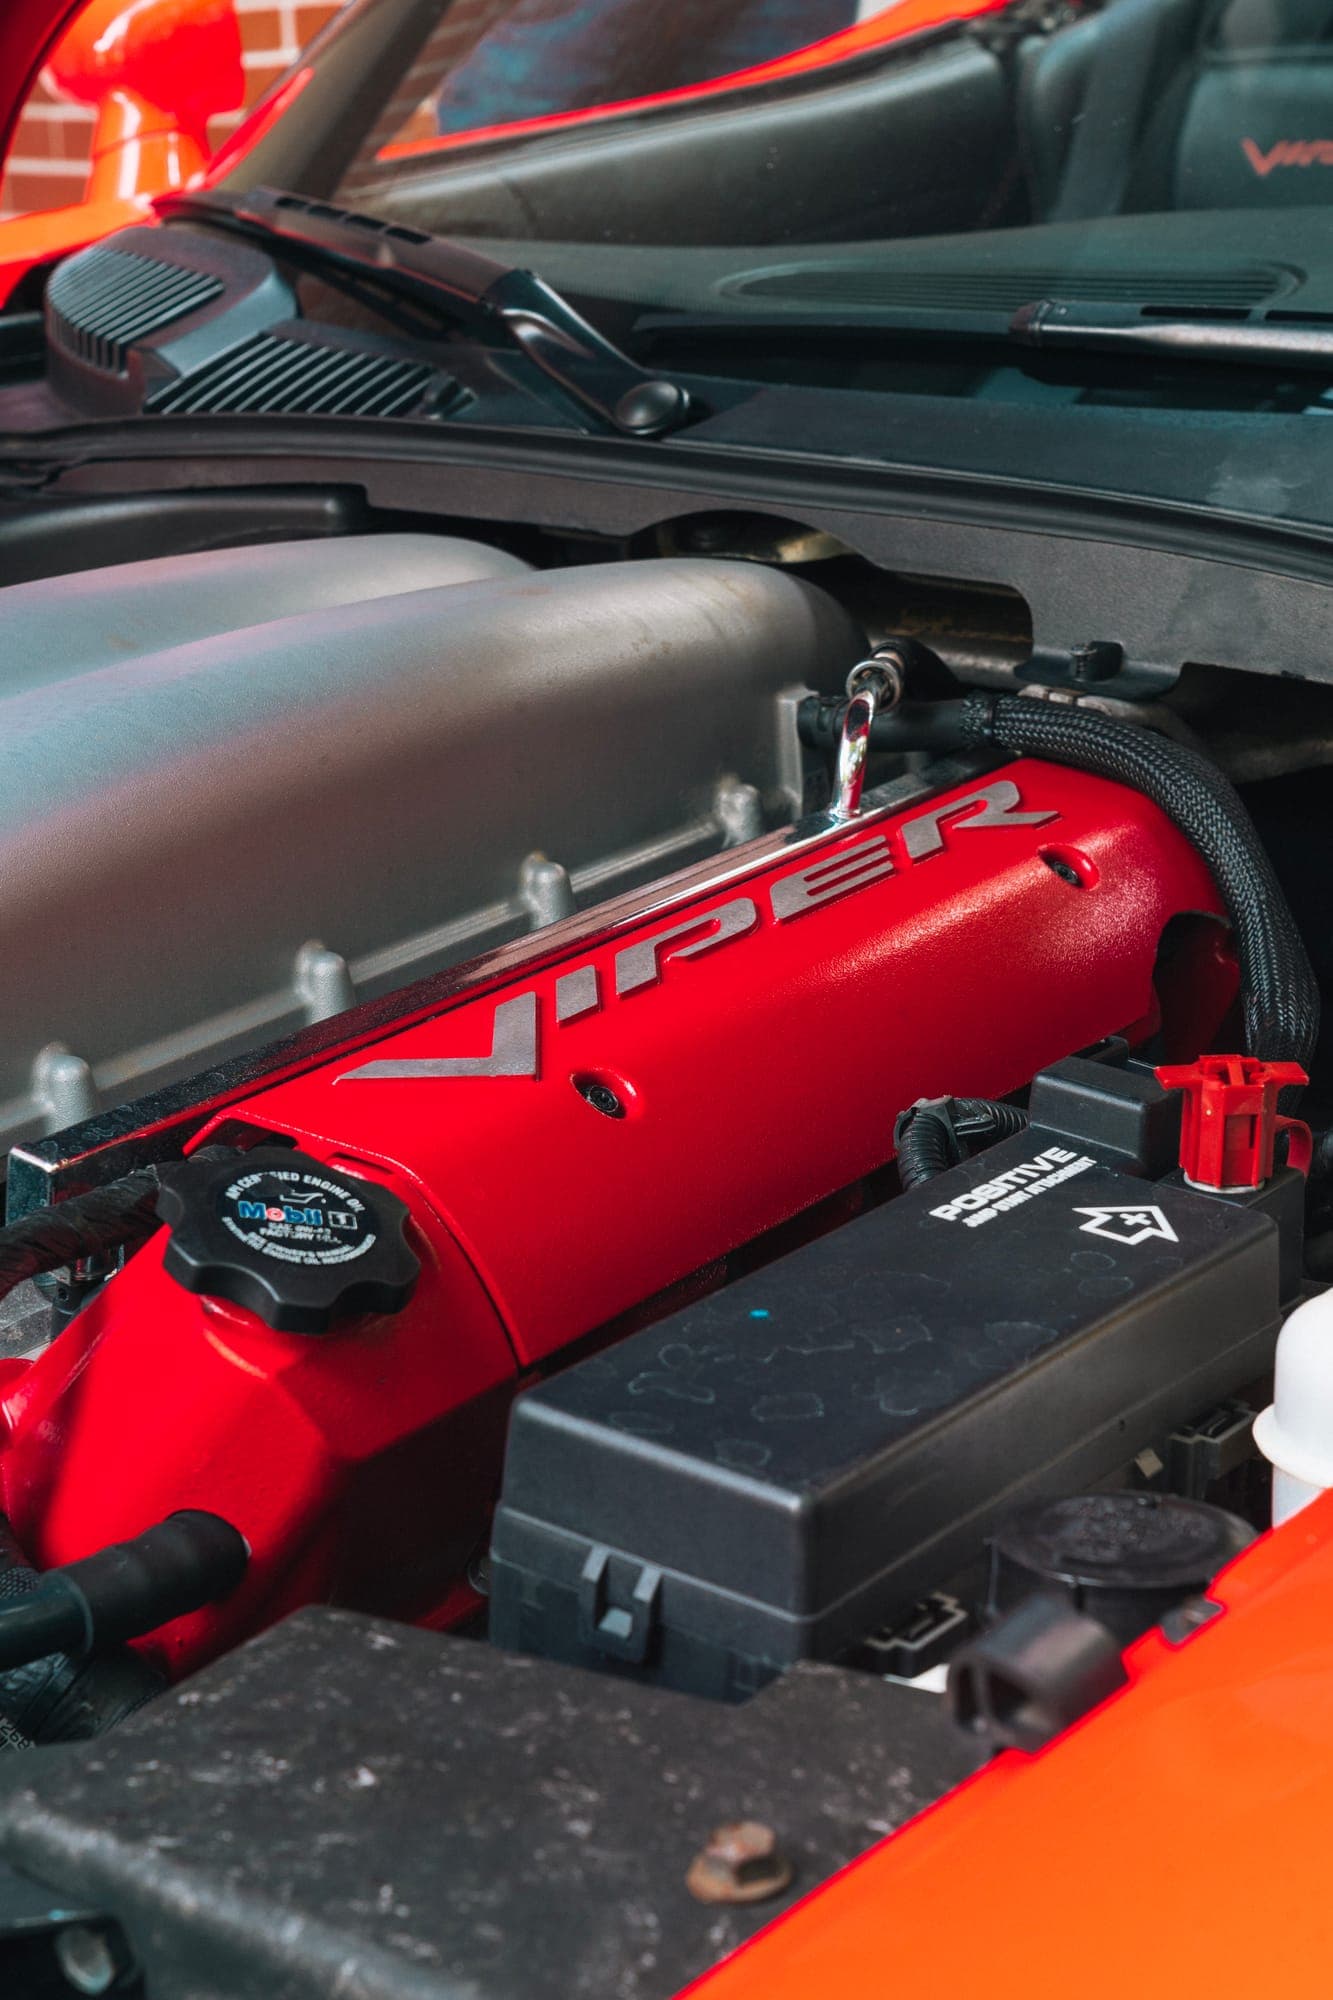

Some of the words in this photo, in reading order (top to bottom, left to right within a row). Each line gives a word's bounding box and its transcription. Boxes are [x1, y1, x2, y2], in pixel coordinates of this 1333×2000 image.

[333, 779, 1060, 1083] VIPER
[303, 1174, 351, 1199] ENGINE
[346, 1198, 366, 1213] OIL
[929, 1146, 1078, 1221] POSITIVE
[238, 1201, 323, 1226] Mobil
